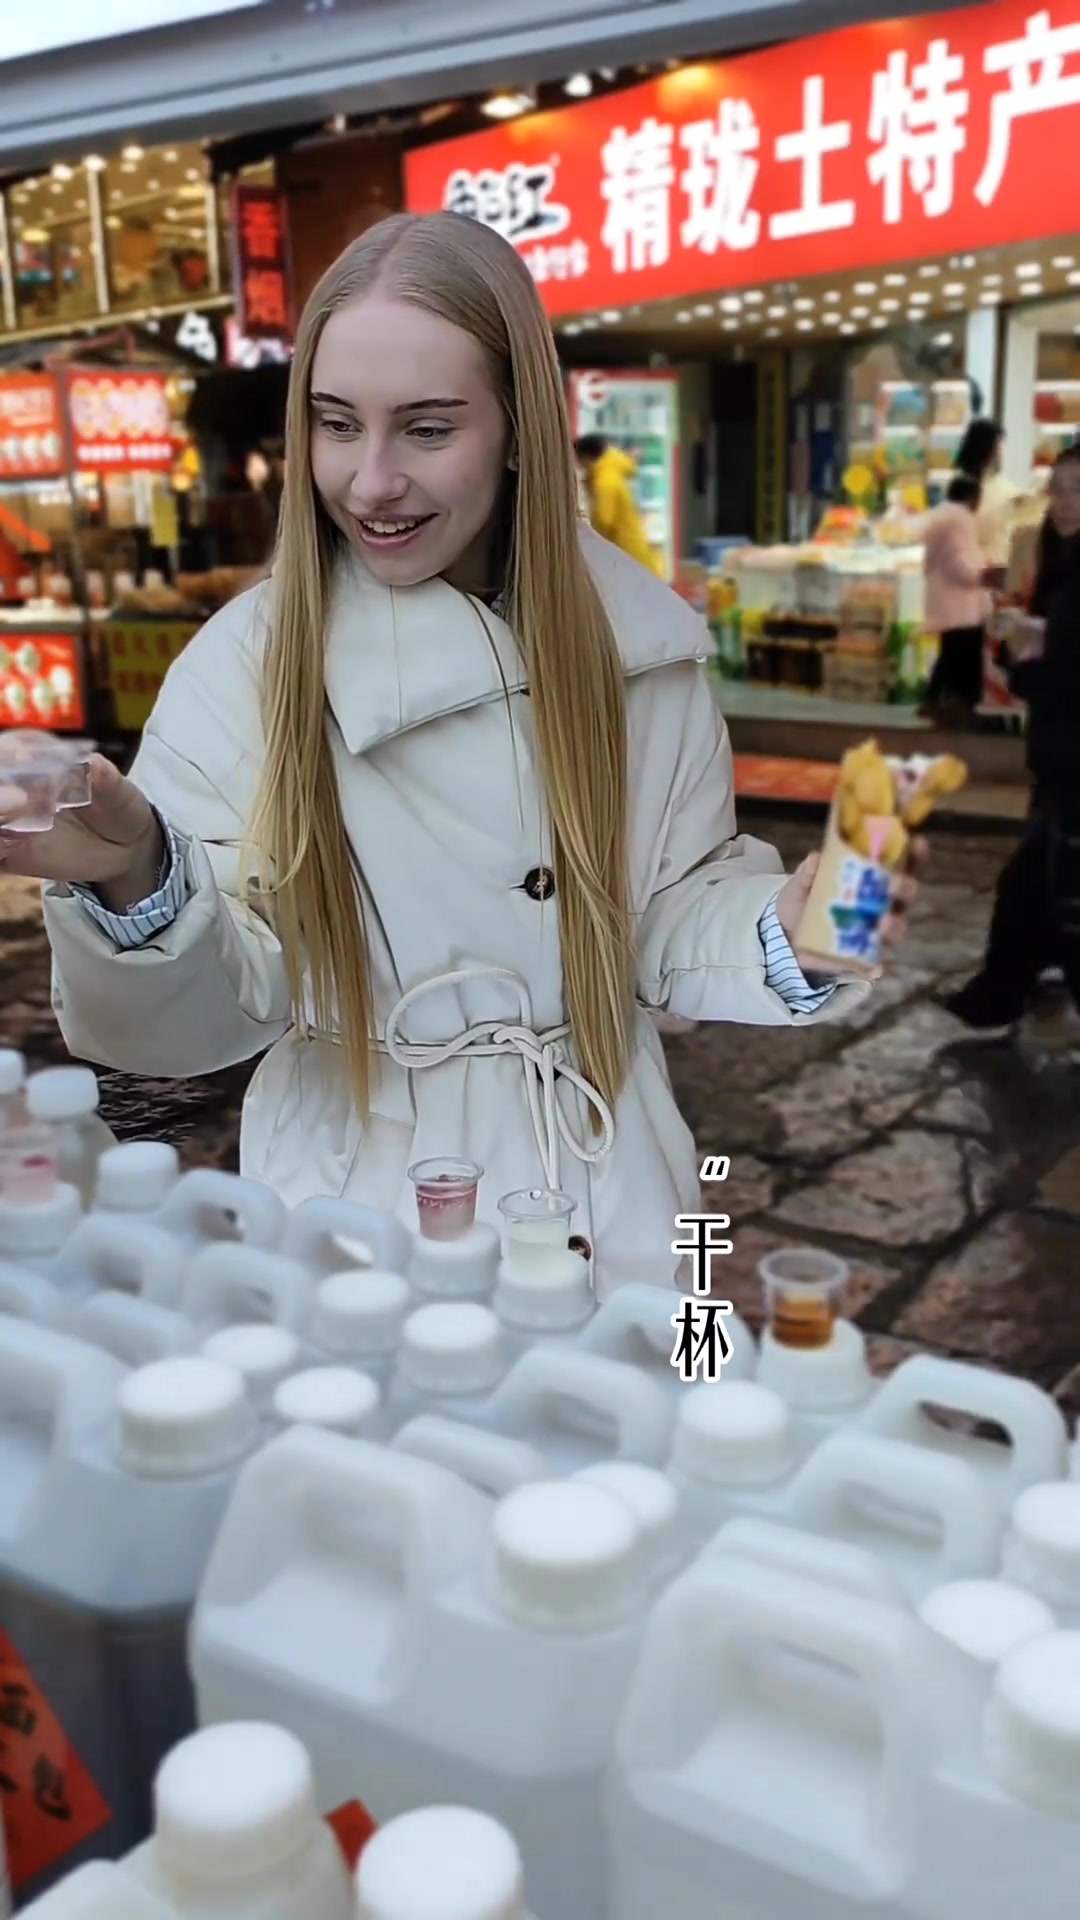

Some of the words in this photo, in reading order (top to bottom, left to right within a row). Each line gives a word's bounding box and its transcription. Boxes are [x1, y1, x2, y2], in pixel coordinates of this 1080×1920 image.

[601, 11, 1080, 273] 精珑土特产
